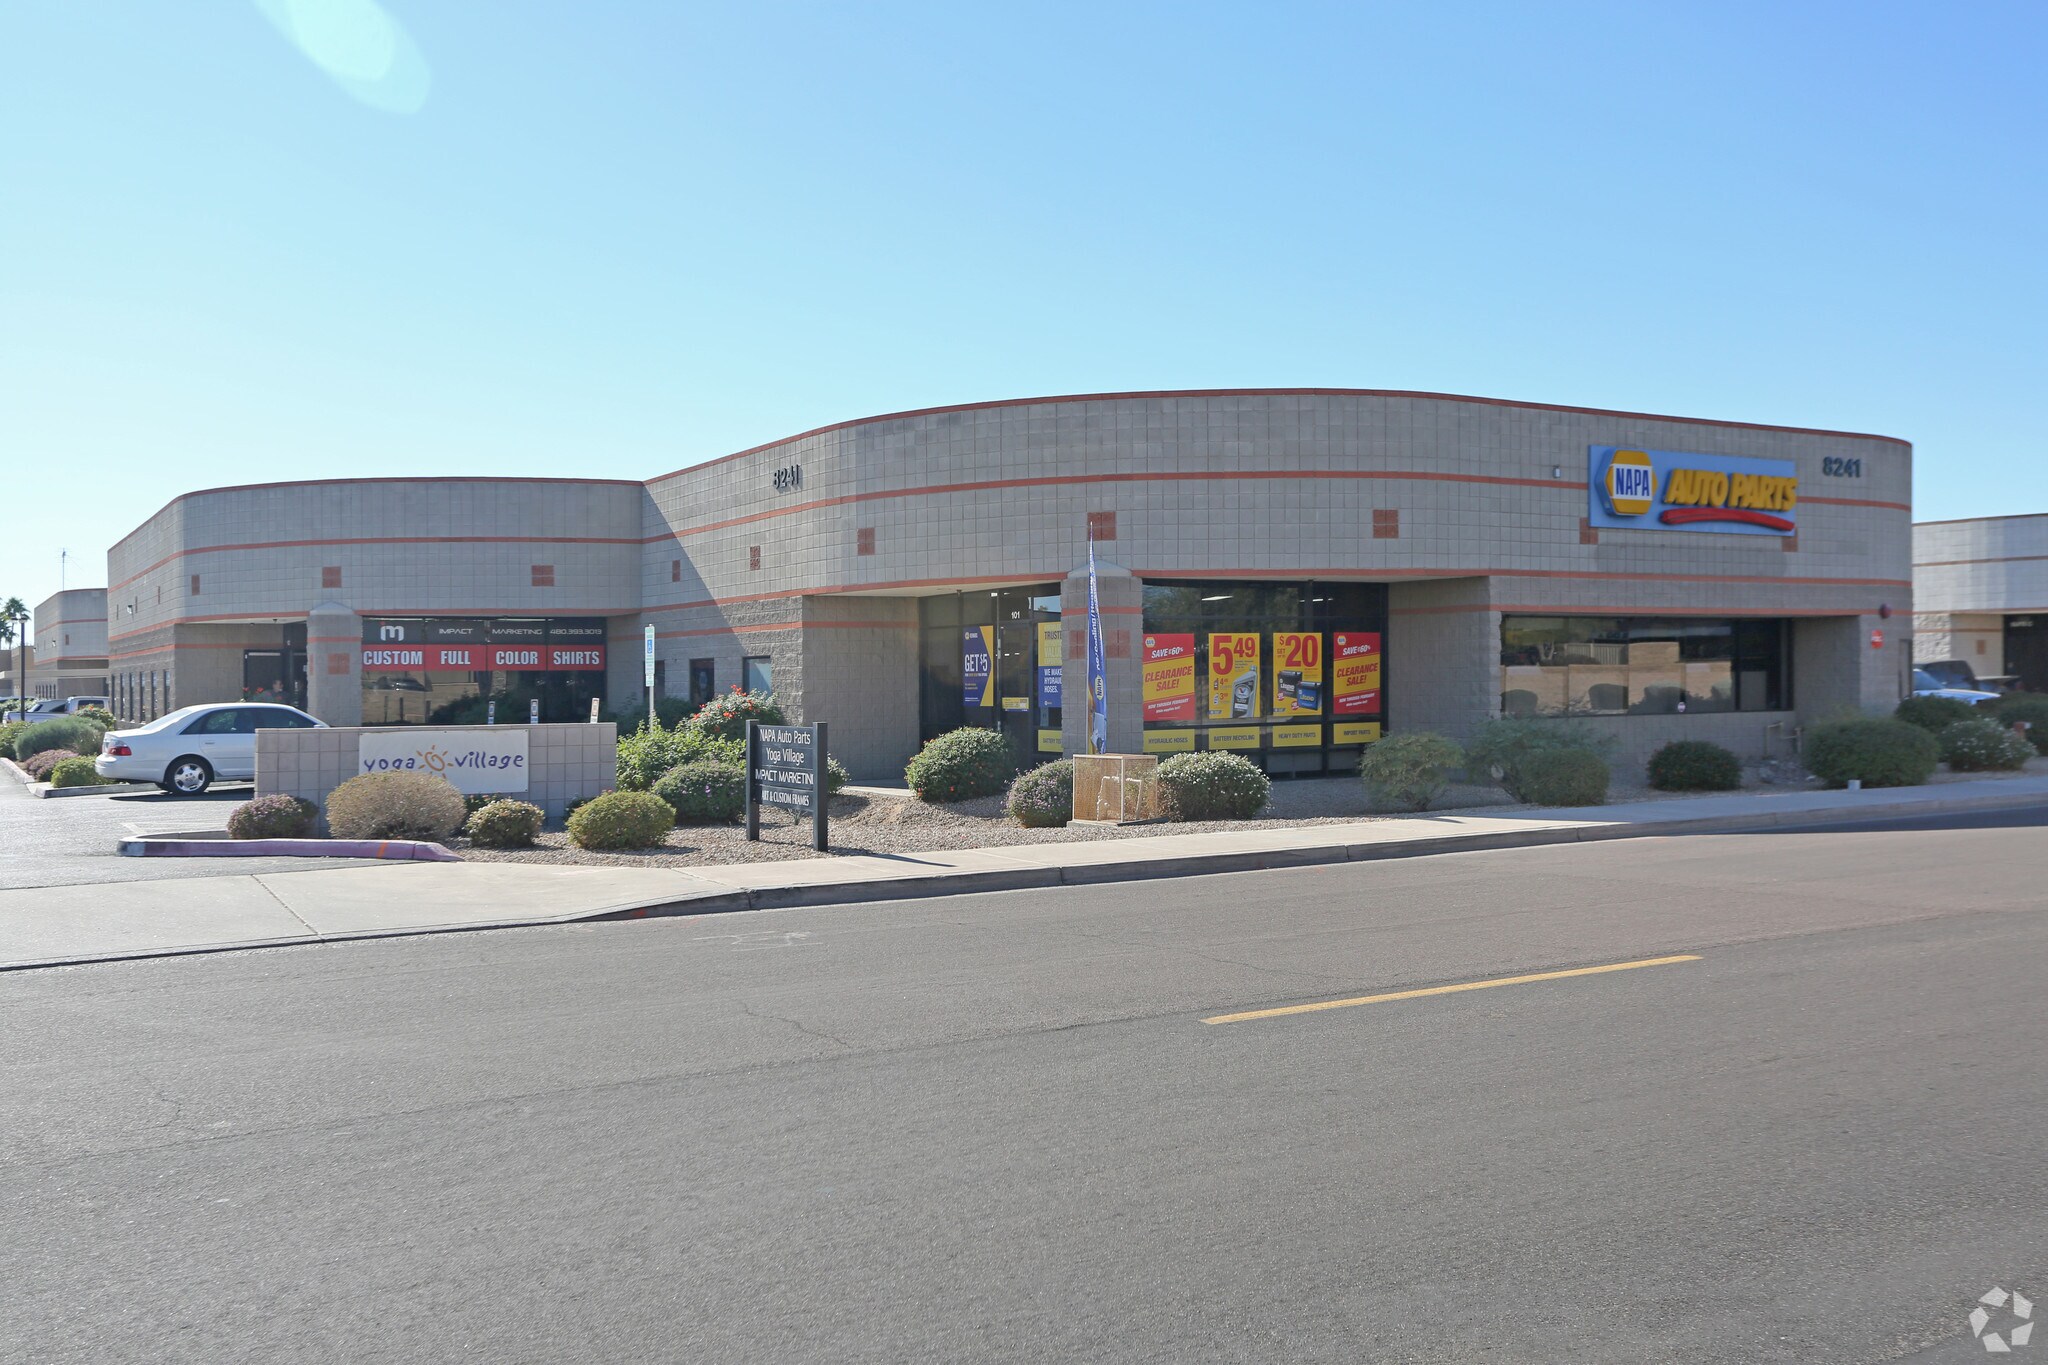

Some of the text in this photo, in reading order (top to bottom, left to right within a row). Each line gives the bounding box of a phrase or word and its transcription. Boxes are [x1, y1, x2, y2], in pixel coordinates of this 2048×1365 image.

[1823, 456, 1862, 478] 8241
[774, 464, 800, 489] 8241
[1615, 467, 1650, 497] NAPA
[1664, 468, 1798, 512] AUTO PARTS
[1011, 611, 1020, 619] 101
[363, 650, 600, 665] CUSTOM FULL COLOR SHIRTS
[1151, 648, 1168, 659] SAVE
[1343, 645, 1358, 656] SAVE
[964, 653, 988, 672] GET $5
[1336, 662, 1379, 678] CLEARANCE
[1145, 665, 1193, 683] CLEARANCE
[1346, 674, 1367, 687] SALE!
[1156, 679, 1180, 692] SALE!
[760, 728, 811, 745] NAPA Auto Parts
[455, 751, 524, 770] village
[766, 747, 805, 766] Yoga Village
[778, 770, 814, 785] MARKETIN
[773, 791, 792, 804] CUSTOM
[792, 793, 809, 806] FRAMES
